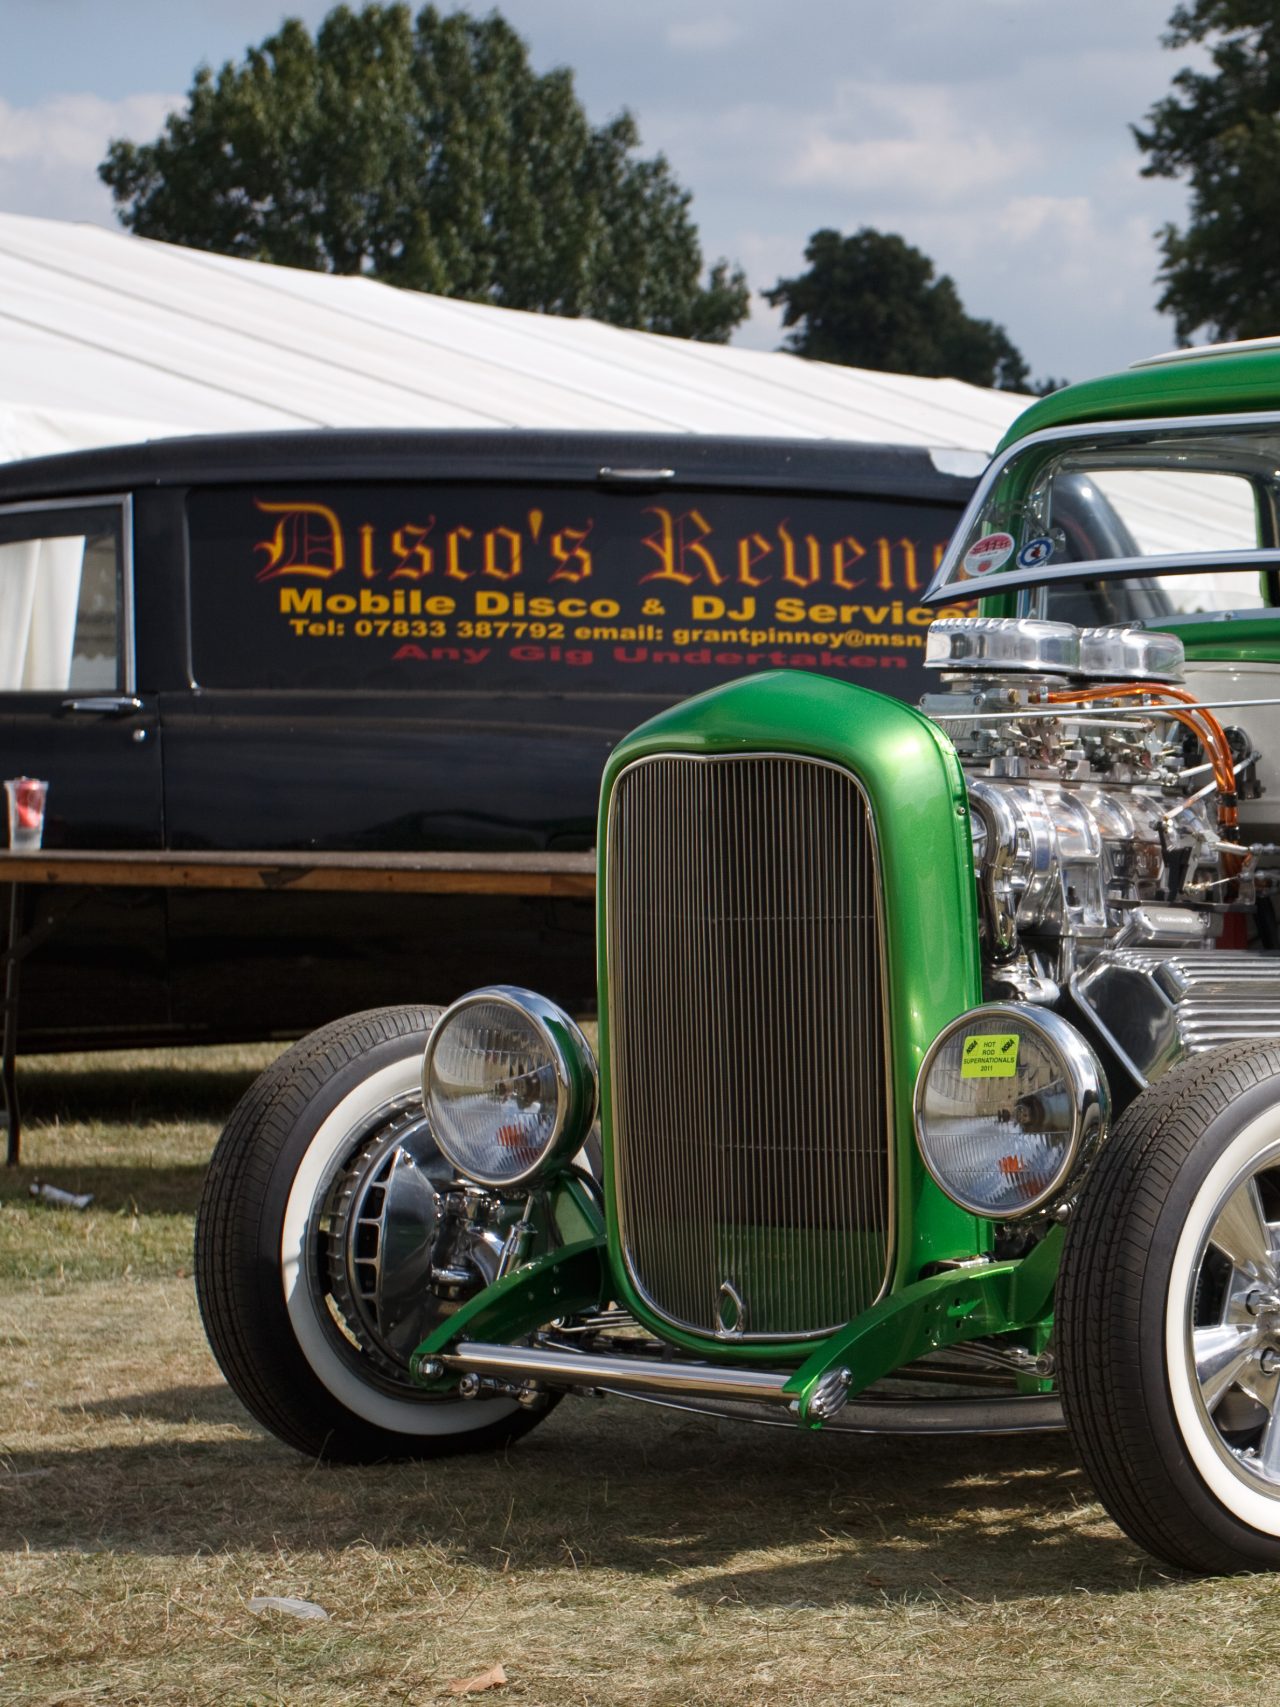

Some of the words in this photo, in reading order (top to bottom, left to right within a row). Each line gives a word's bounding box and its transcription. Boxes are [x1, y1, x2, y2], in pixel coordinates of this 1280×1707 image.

[252, 497, 594, 583] Disco's
[279, 588, 456, 615] Mobile
[475, 591, 621, 618] Disco
[641, 598, 666, 616] &
[692, 595, 756, 622] DJ
[774, 599, 977, 625] Service
[289, 618, 345, 636] Tel:
[355, 620, 447, 637] 07833
[456, 621, 566, 640] 387792
[574, 624, 663, 642] email:
[673, 627, 927, 649] grantpinney@msn.
[391, 644, 491, 664] Any
[509, 646, 594, 666] Gig
[612, 647, 908, 669] Undertaken
